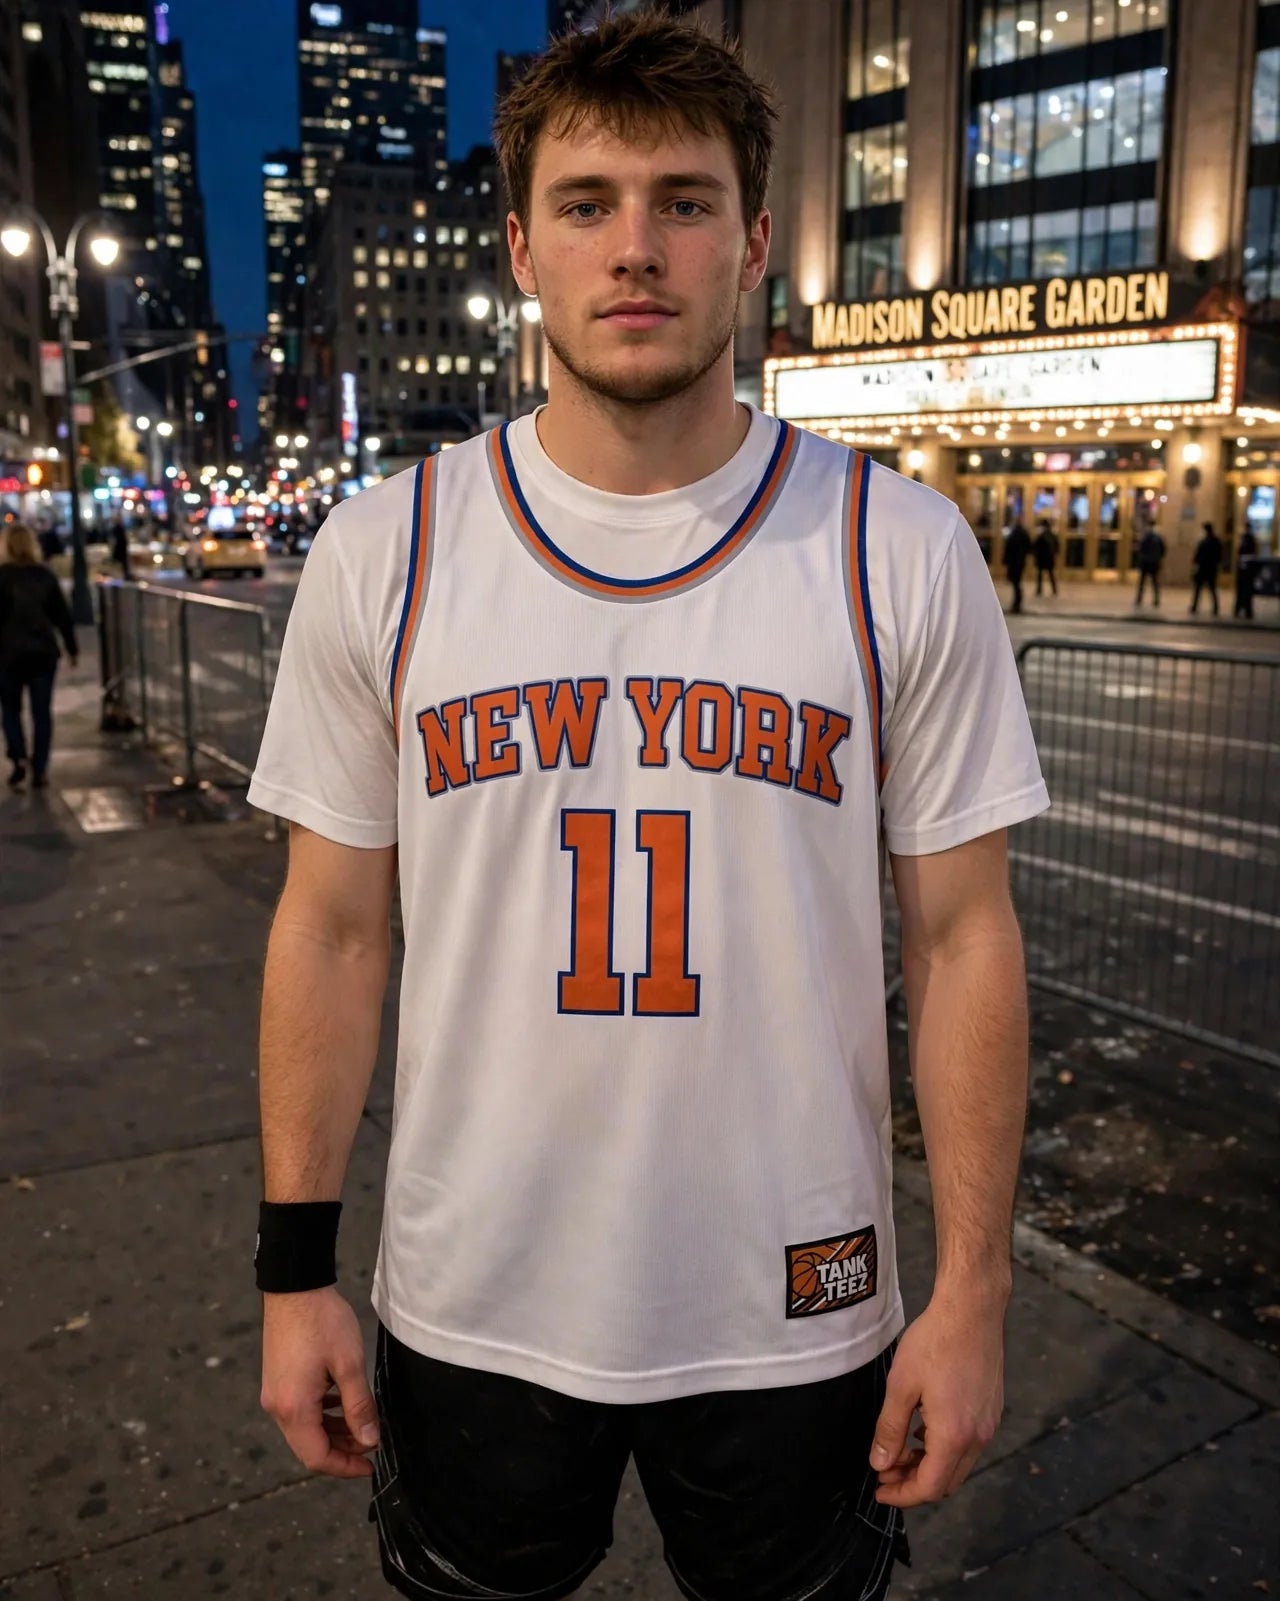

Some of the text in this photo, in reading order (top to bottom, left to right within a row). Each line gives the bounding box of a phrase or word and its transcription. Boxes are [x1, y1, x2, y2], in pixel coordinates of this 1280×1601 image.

[812, 272, 1168, 349] MADISON SQUARE GARDEN
[416, 676, 853, 807] NEW YORK
[557, 808, 700, 1017] 11
[816, 1253, 868, 1283] TANK
[824, 1272, 868, 1301] TEEZ
